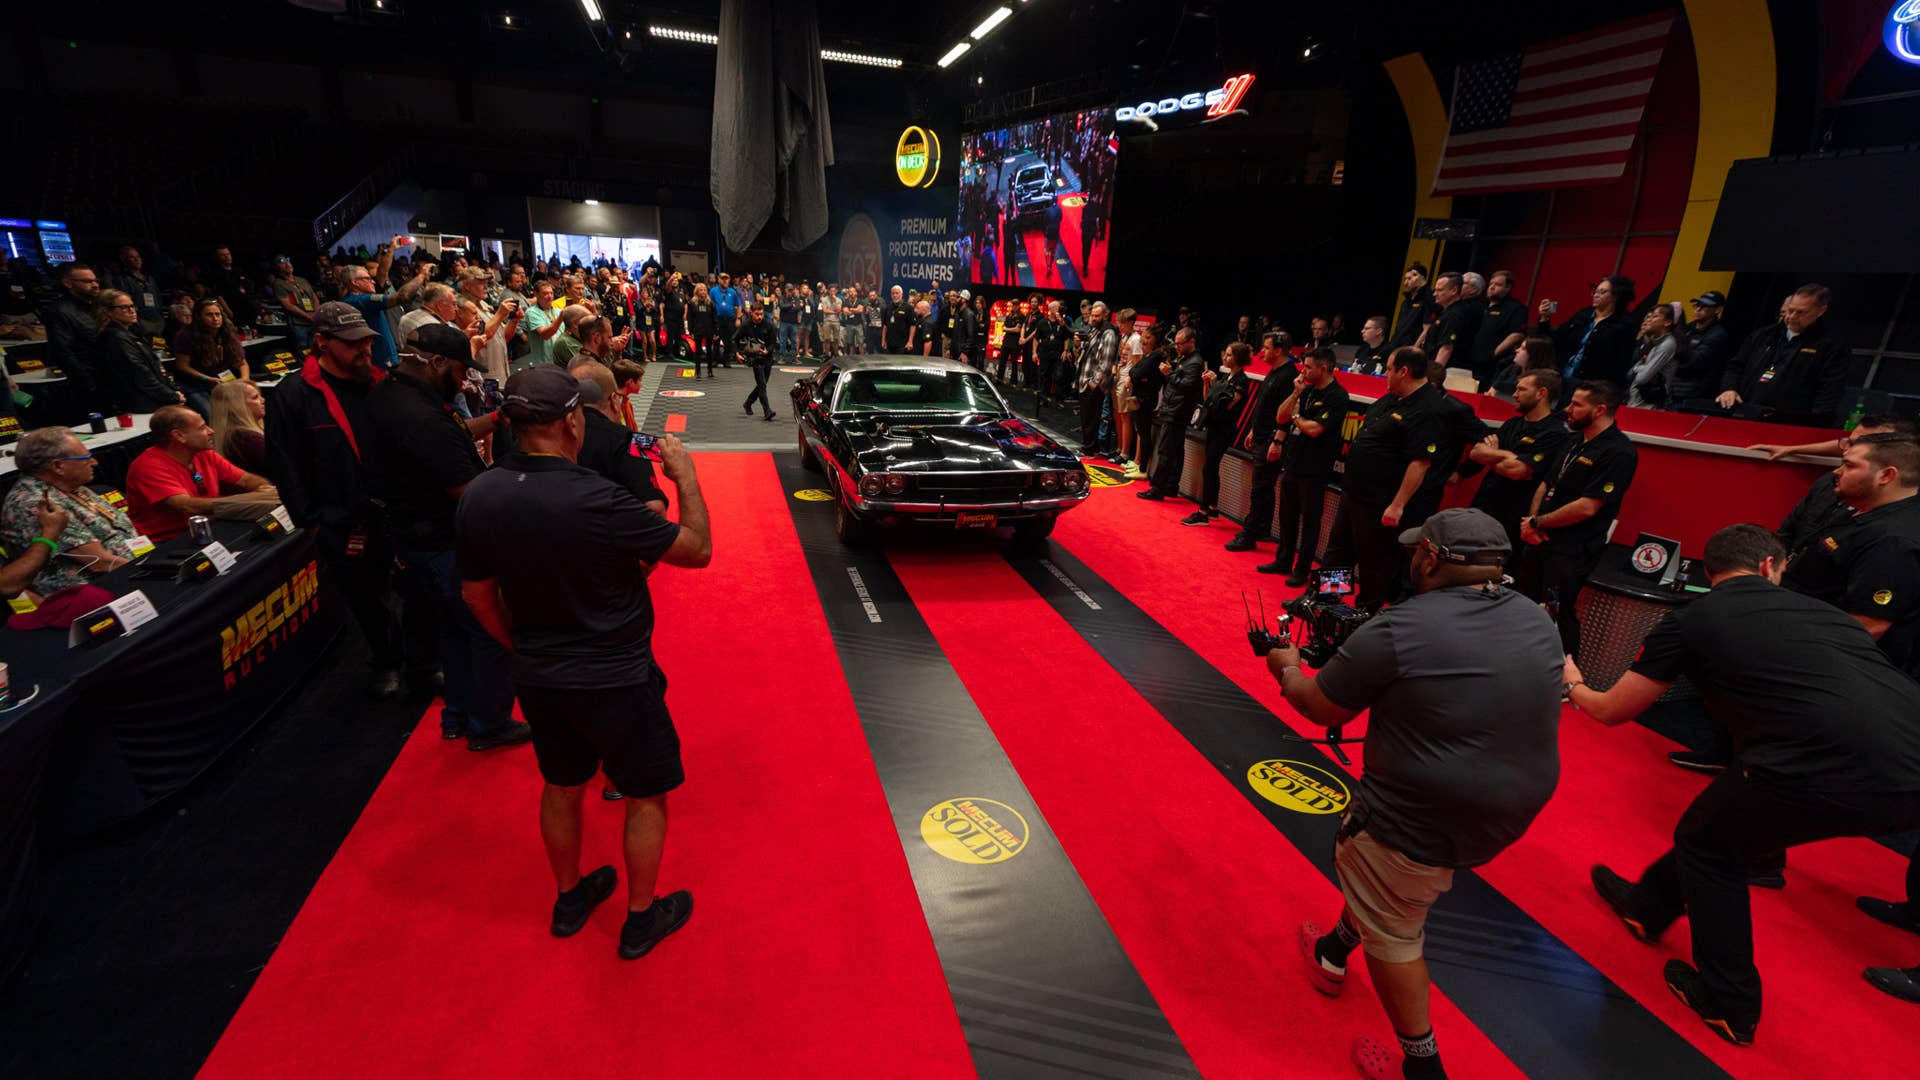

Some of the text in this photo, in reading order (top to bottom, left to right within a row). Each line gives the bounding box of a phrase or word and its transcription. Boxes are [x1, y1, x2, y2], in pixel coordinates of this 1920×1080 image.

[1115, 88, 1227, 121] DODGE
[897, 155, 907, 169] ON
[901, 217, 946, 235] PREMIUM
[889, 241, 958, 258] PROTECTANTS
[893, 262, 953, 281] & CLEANERS
[220, 559, 319, 671] MECUM
[223, 597, 319, 691] AUCTIONS
[1251, 767, 1335, 811] SOLD
[1270, 761, 1346, 801] MECUM
[930, 807, 1002, 860] SOLD
[957, 800, 1022, 849] MECUM
